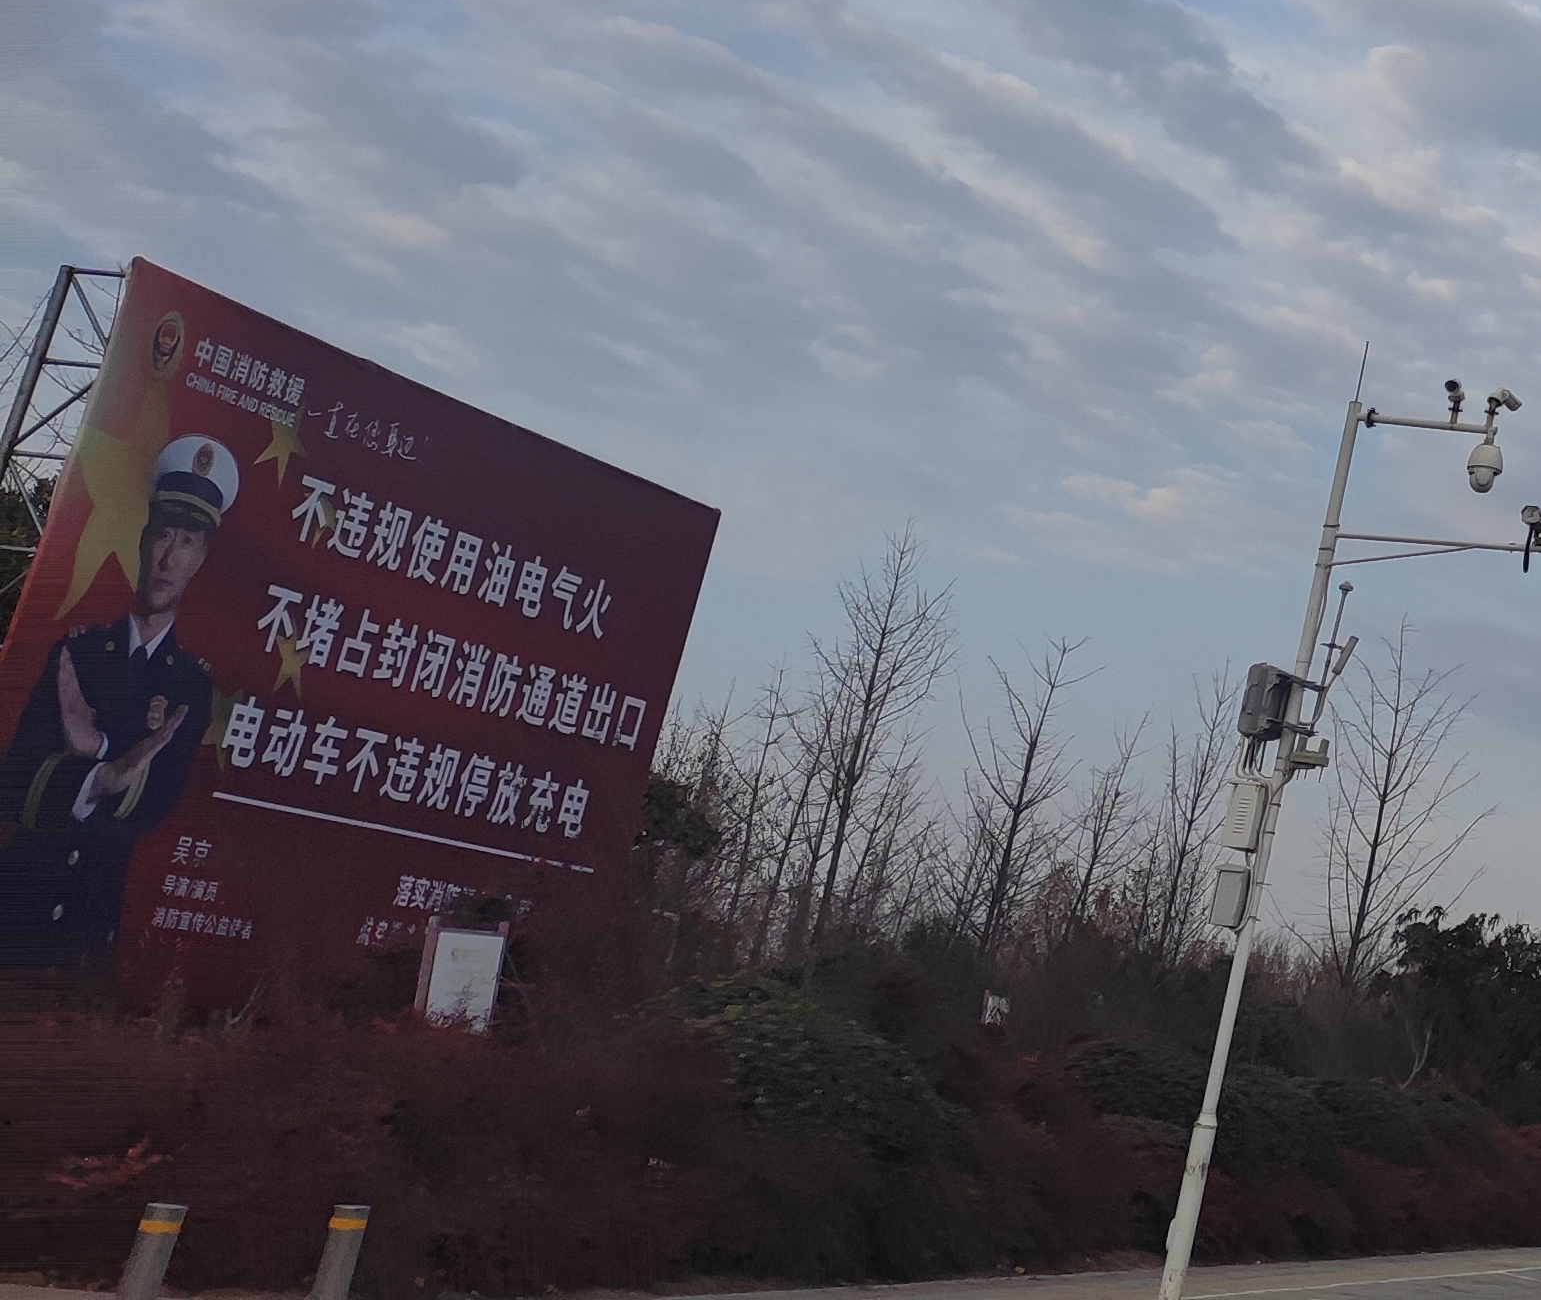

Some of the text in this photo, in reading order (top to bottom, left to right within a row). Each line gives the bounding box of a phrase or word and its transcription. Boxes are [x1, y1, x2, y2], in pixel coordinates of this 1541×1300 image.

[185, 372, 297, 428] CHINA FIRE AND RESCUE
[194, 337, 306, 407] 中国消防救援
[291, 474, 613, 640] 不违规使用油电气火
[257, 584, 648, 752] 不堵占封闭消防通道出口
[221, 695, 591, 840] 电动车不违规停放充电
[170, 836, 213, 868] 吴京
